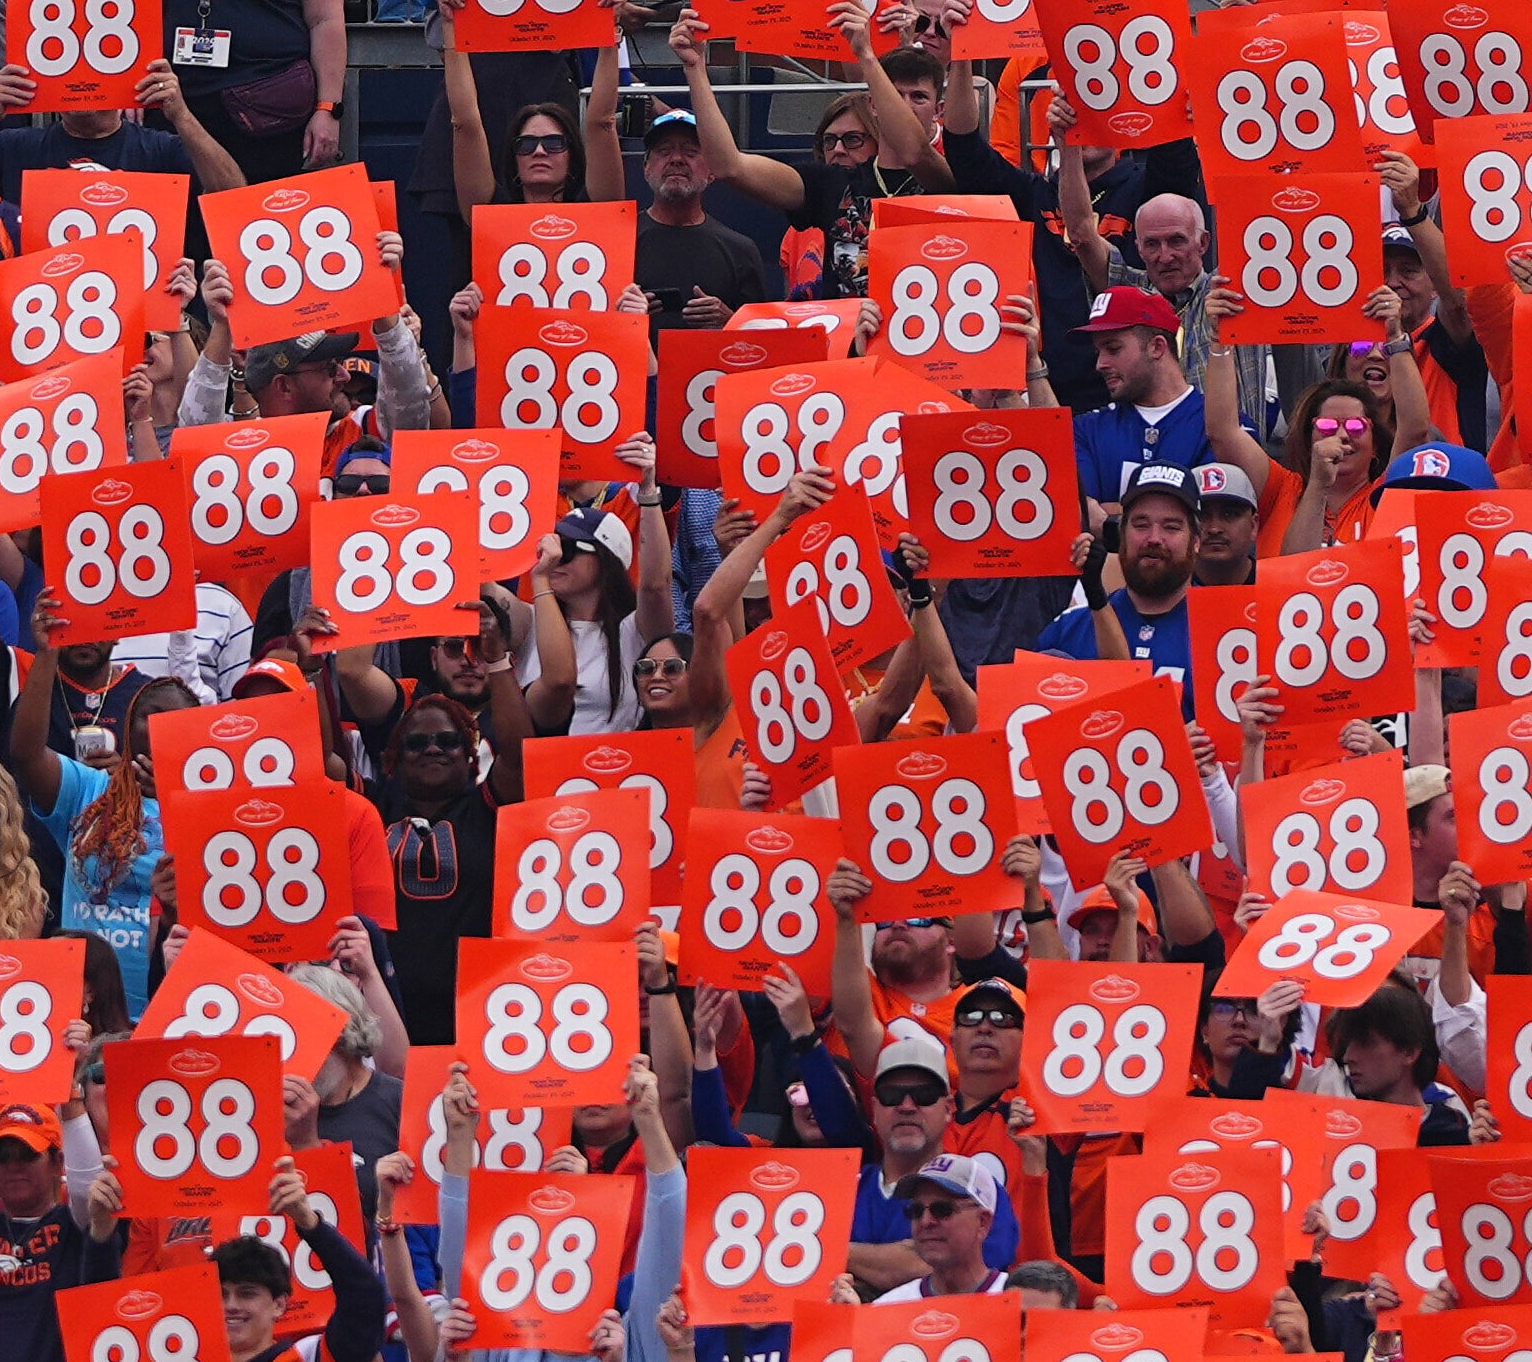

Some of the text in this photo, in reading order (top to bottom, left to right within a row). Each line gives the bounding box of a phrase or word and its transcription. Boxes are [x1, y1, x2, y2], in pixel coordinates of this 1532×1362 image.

[1420, 31, 1529, 118] 88
[191, 447, 298, 545] 88
[934, 449, 1053, 541] 88
[1137, 465, 1187, 488] GIANTS
[105, 929, 144, 950] NOT
[1043, 1004, 1166, 1096] 88
[479, 1215, 596, 1312] 88
